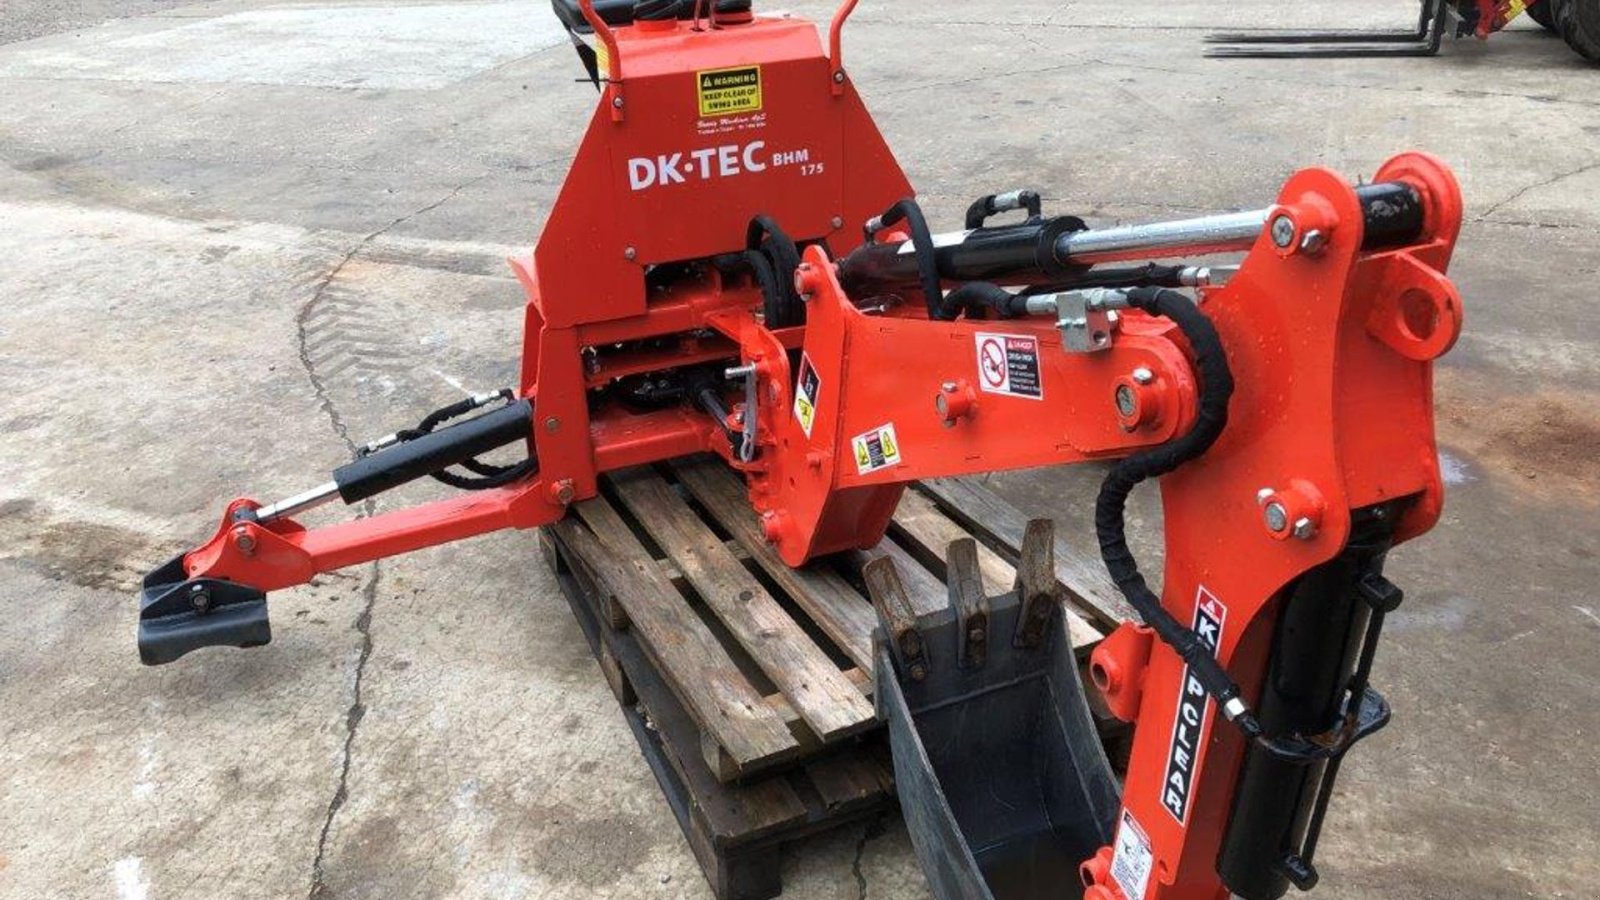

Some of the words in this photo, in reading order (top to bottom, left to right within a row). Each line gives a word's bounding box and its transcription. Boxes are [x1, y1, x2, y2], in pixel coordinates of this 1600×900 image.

[714, 73, 756, 86] WARNING
[704, 92, 723, 100] KEEP
[723, 89, 746, 98] CLEAR
[733, 98, 751, 106] AREA
[772, 148, 809, 167] BHM
[800, 163, 824, 176] 175
[1165, 702, 1199, 815] CLEAR
